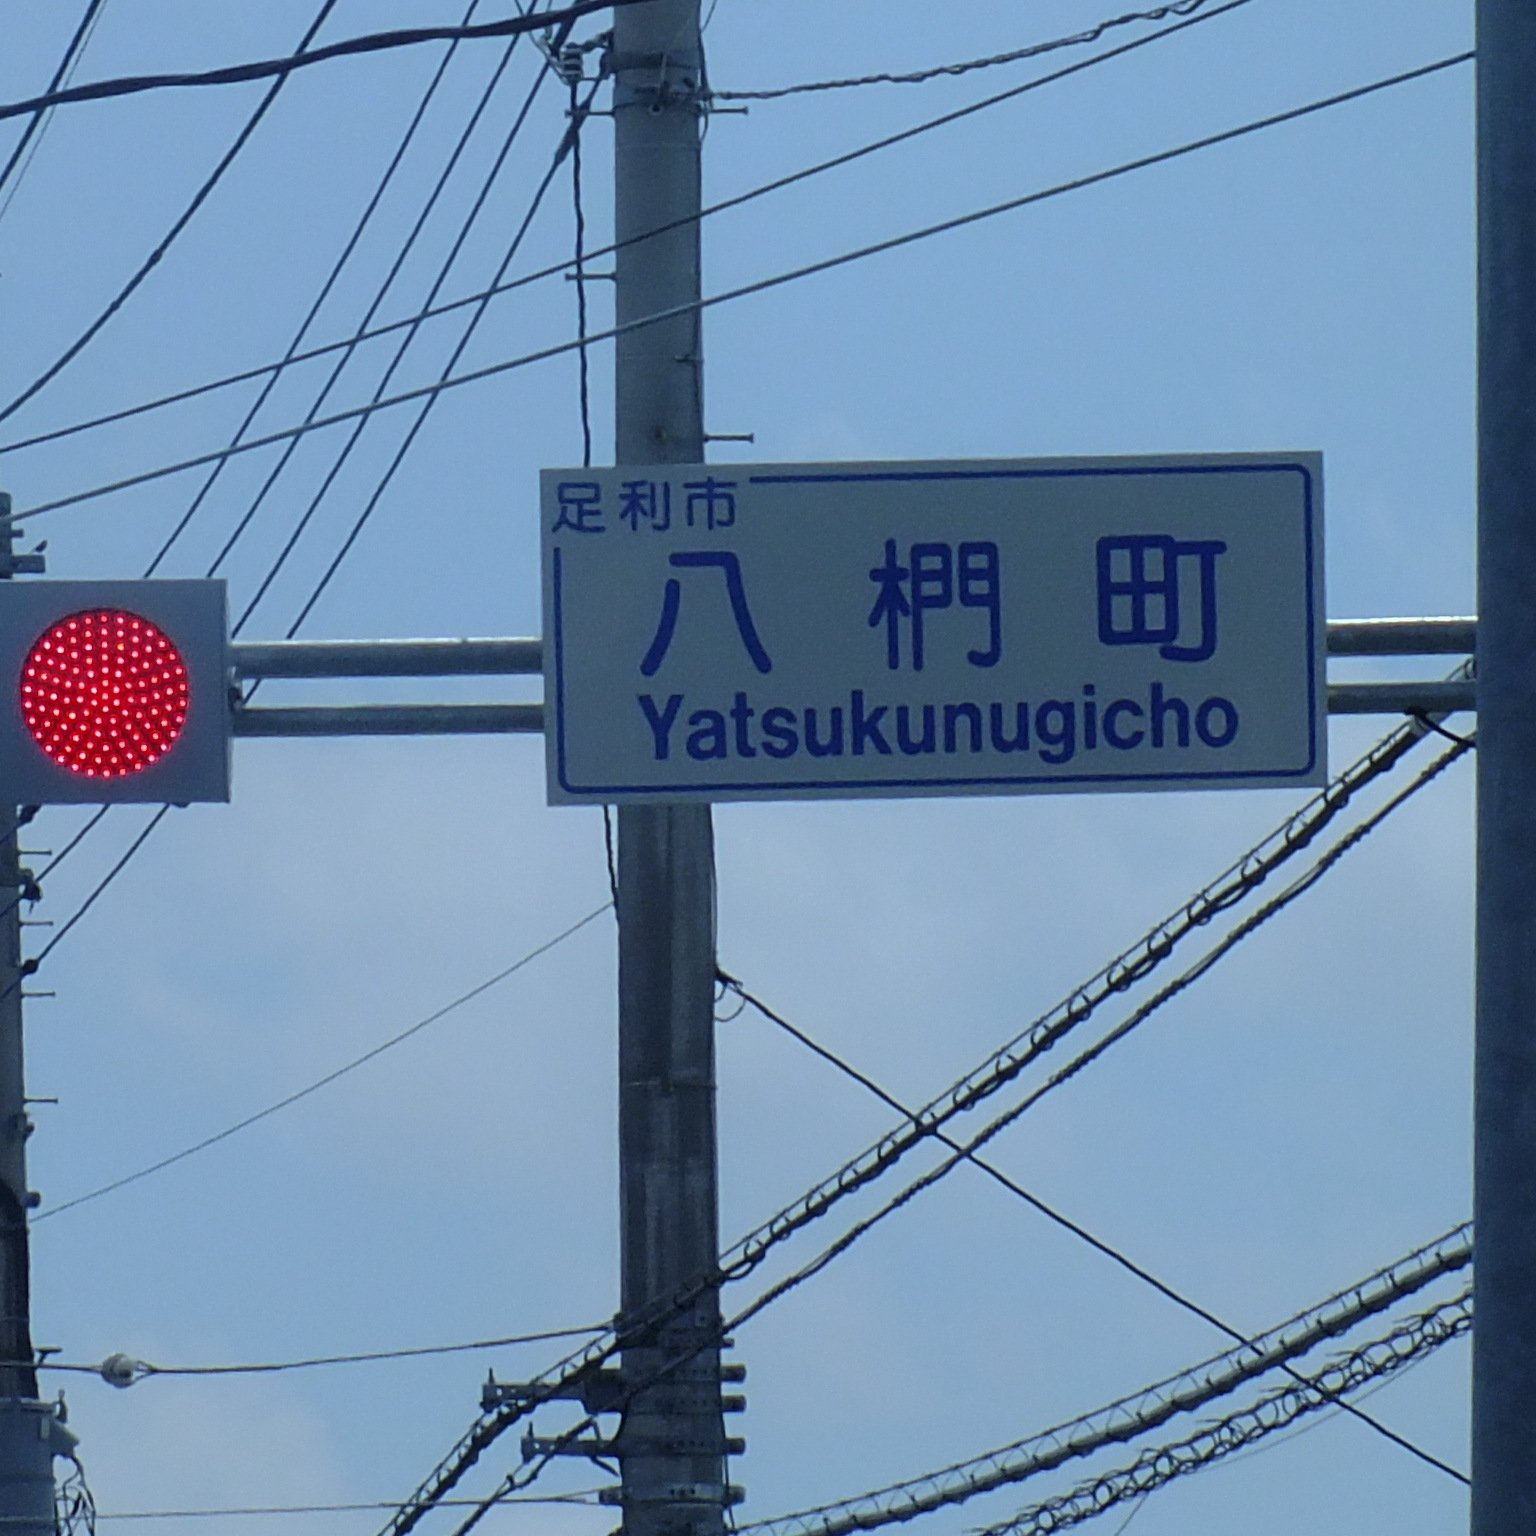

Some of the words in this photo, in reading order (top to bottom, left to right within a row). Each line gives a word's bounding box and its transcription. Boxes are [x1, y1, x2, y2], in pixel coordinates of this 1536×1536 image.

[552, 476, 738, 533] 足利市
[639, 534, 1228, 677] 八椚町
[637, 681, 1239, 765] Yatsukunugicho
